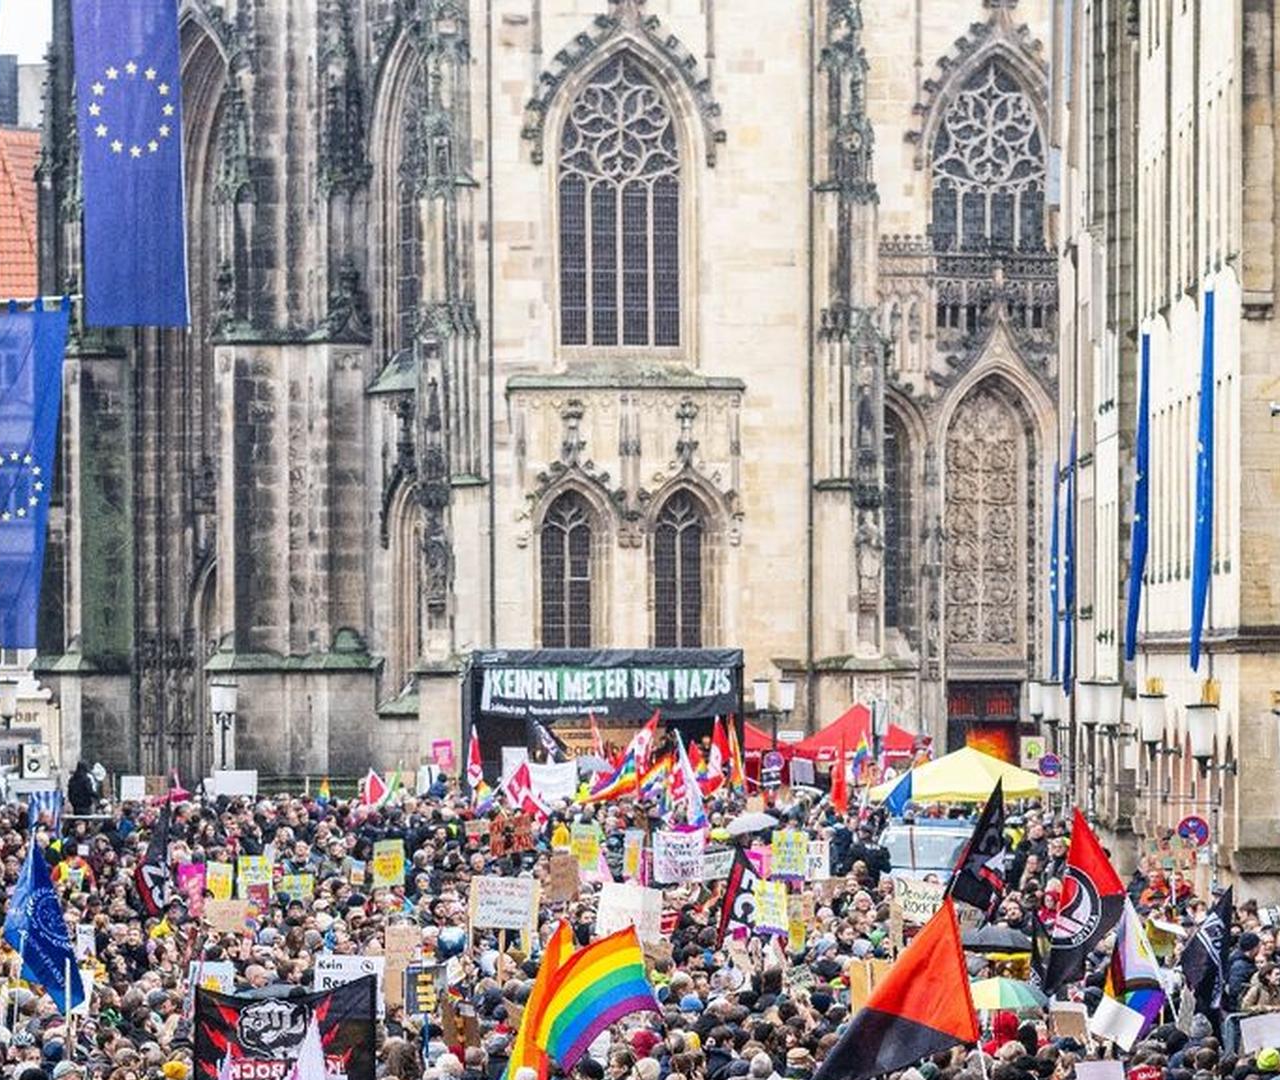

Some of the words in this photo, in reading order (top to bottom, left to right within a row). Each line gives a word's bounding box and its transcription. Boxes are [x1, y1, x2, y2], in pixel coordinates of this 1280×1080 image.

[488, 667, 558, 700] KEINEN
[563, 669, 630, 701] METER
[633, 669, 669, 699] DEN
[674, 668, 733, 699] NAZIS
[318, 959, 343, 970] Kein
